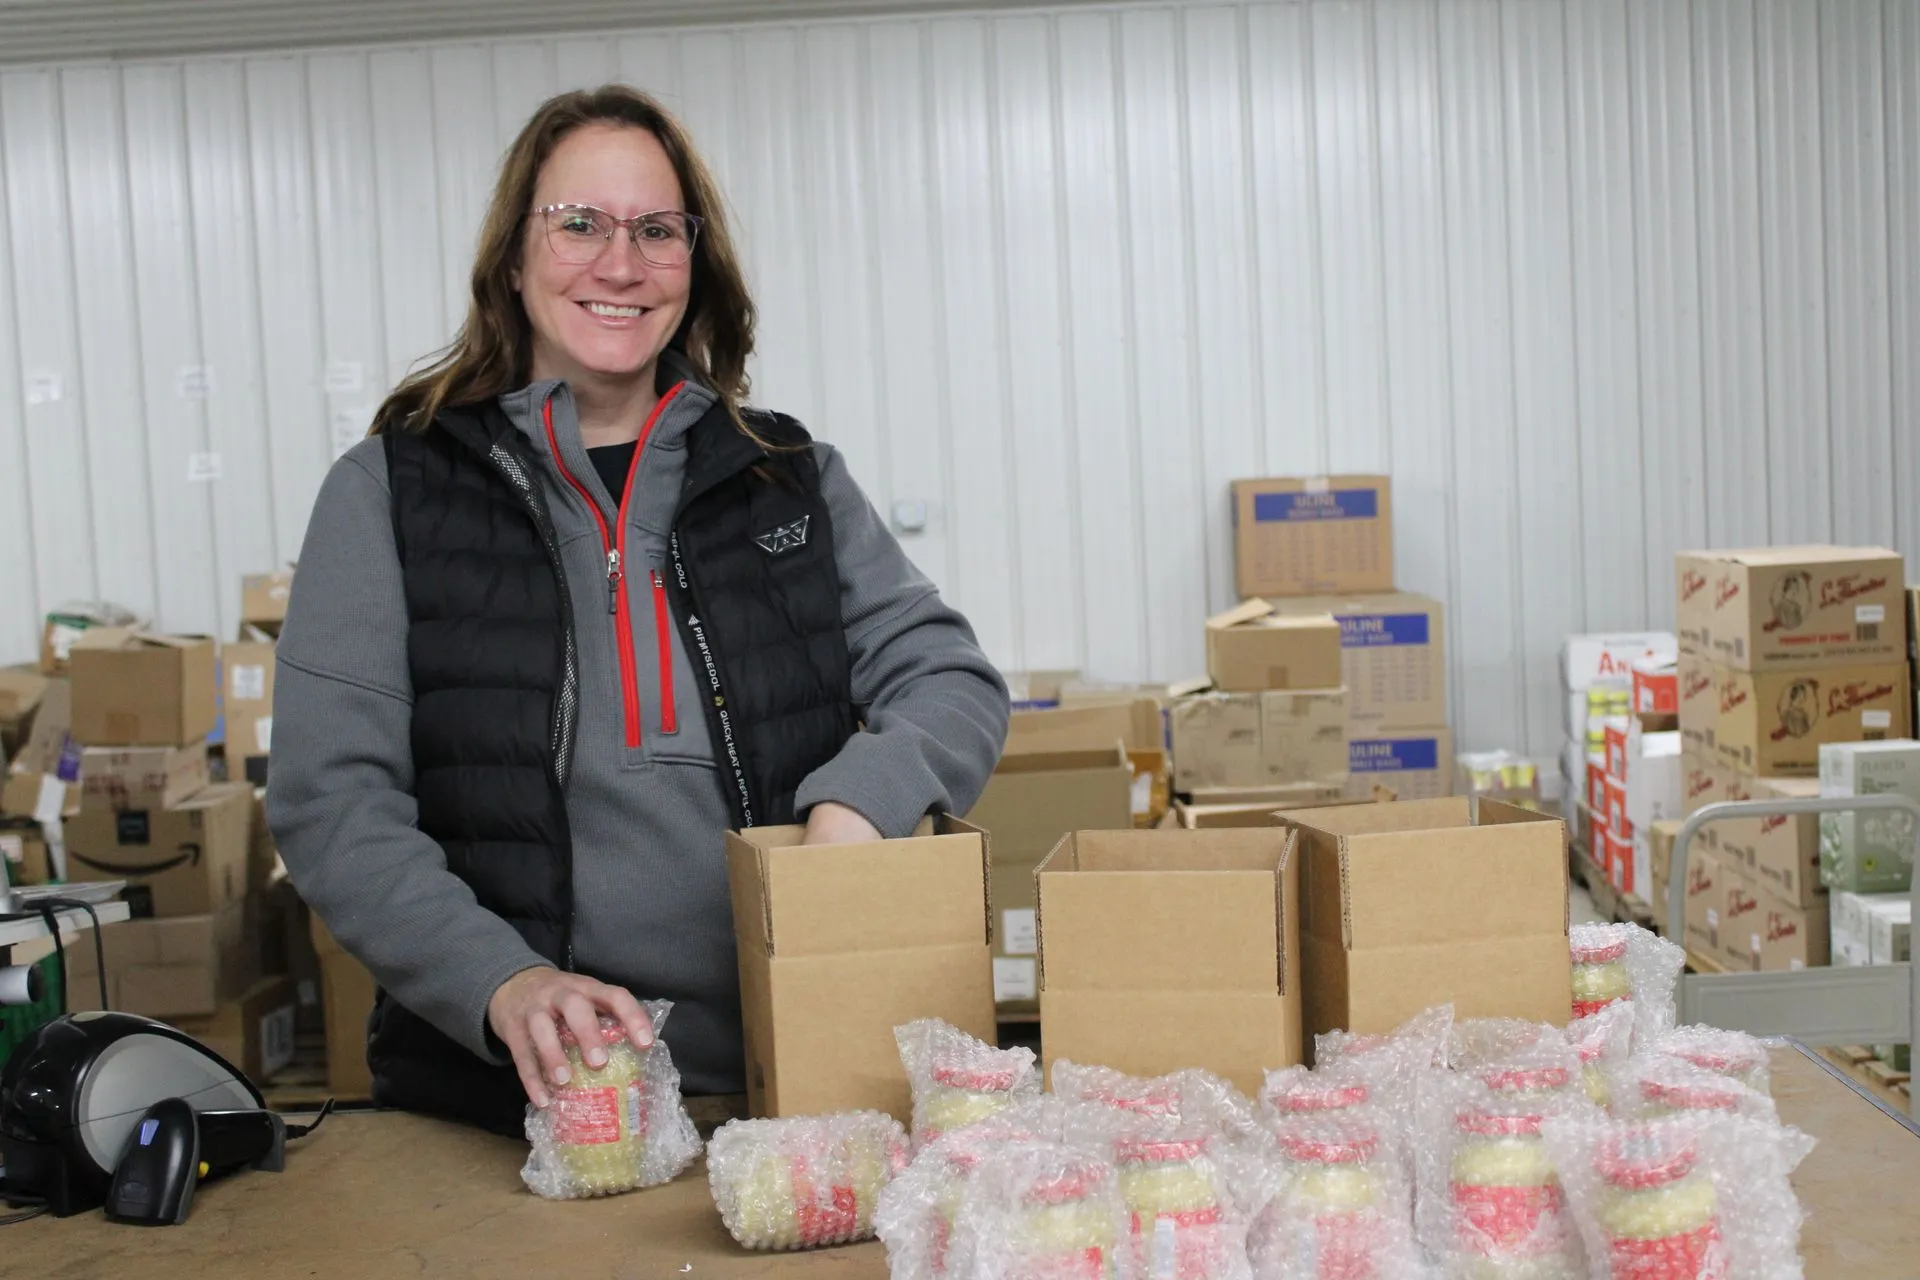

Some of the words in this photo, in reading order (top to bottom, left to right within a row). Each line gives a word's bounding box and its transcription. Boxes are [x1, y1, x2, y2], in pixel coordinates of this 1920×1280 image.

[675, 563, 688, 589] COLD
[720, 710, 733, 743] QUICK
[727, 742, 740, 768] HEAT
[735, 769, 742, 778] &
[744, 809, 753, 829] COL
